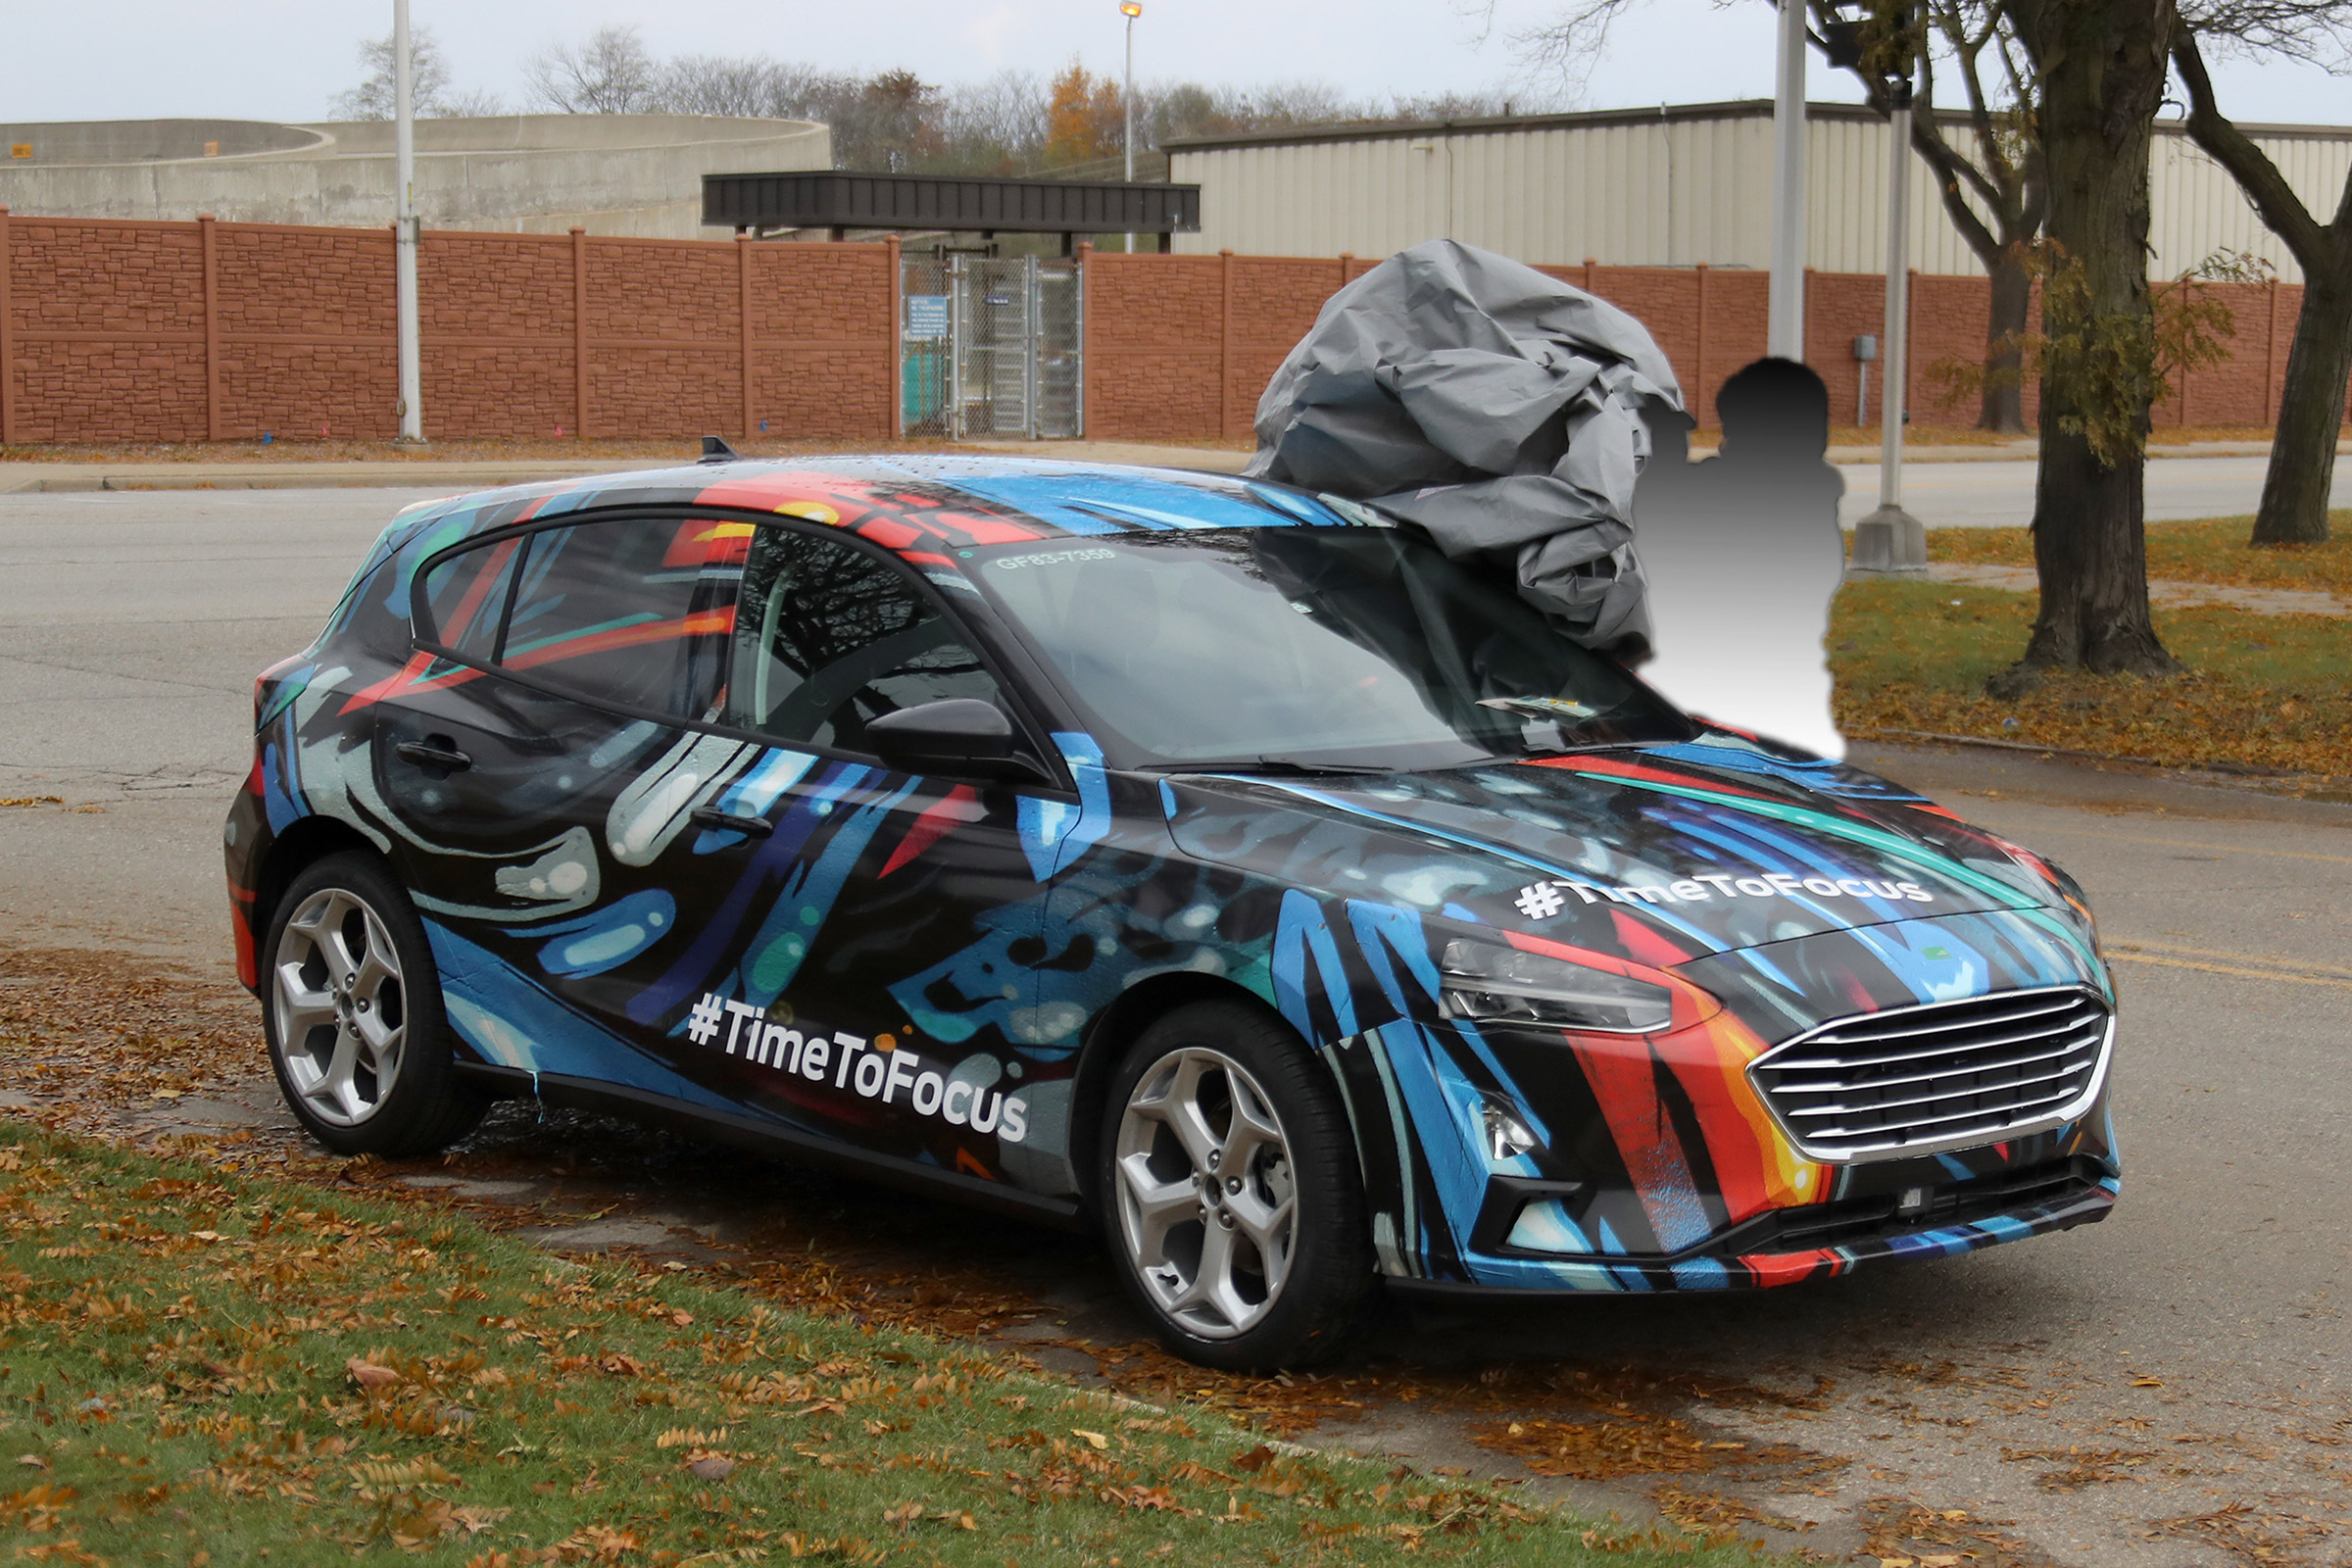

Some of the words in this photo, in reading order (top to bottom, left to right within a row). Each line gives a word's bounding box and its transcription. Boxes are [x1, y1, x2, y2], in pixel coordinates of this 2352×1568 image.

[996, 548, 1115, 569] GF83-7359
[1513, 873, 1934, 920] #TimeToFocus
[687, 992, 1028, 1143] #TimeToFocus
